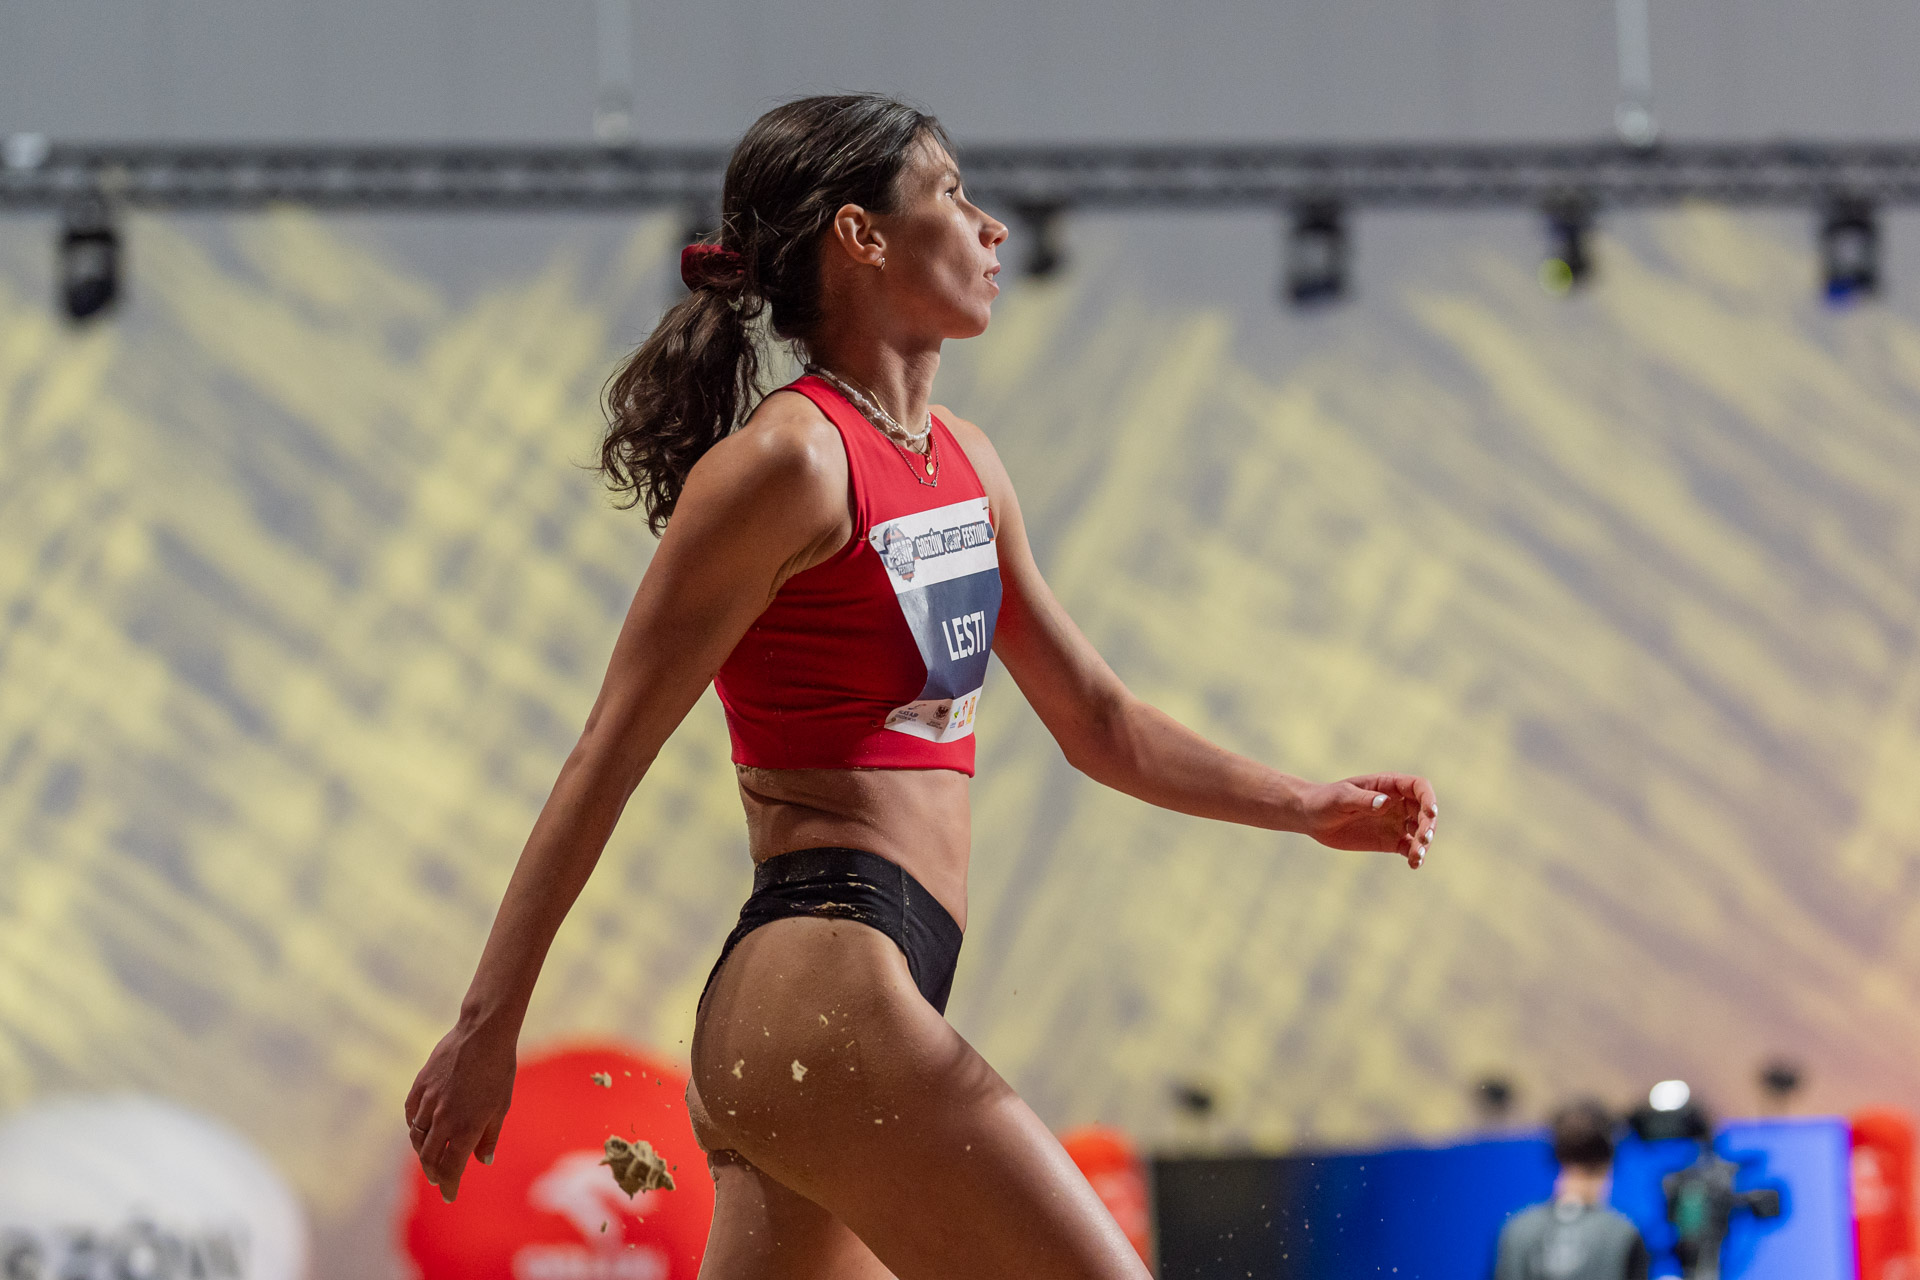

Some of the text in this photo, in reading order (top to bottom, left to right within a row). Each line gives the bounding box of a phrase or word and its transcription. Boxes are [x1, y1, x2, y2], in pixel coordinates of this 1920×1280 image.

[915, 531, 944, 558] GORZÓW
[961, 523, 989, 548] FESTIVAL
[942, 610, 986, 661] LESTI
